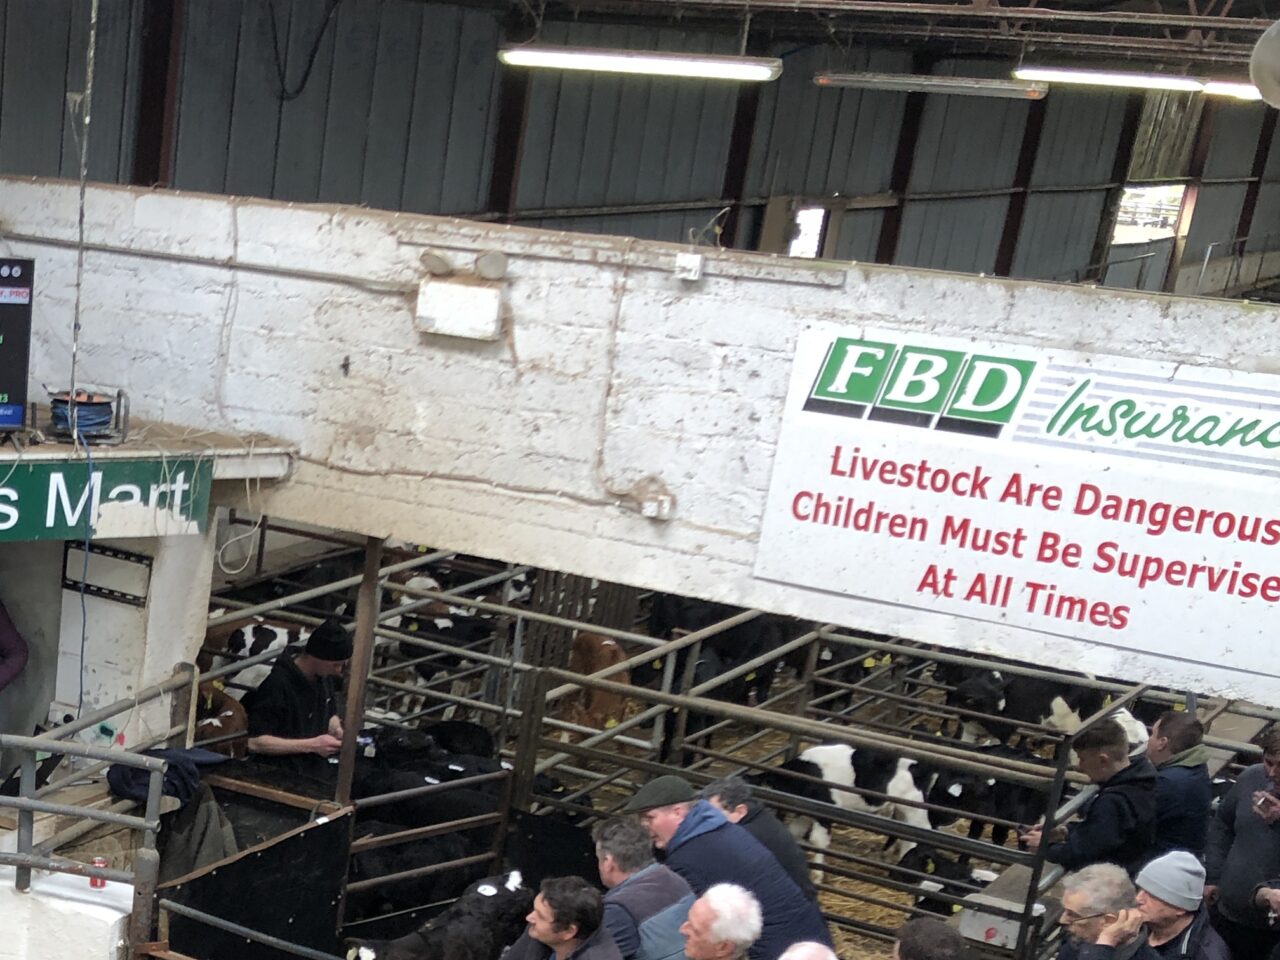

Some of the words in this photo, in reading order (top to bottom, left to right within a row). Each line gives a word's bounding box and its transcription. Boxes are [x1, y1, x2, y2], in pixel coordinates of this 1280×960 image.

[826, 344, 1022, 412] FBD
[1046, 379, 1280, 449] Insuranc
[790, 490, 928, 542] Children
[940, 515, 1027, 559] Must
[1036, 531, 1082, 568] Be
[1092, 541, 1280, 603] Supervise
[830, 445, 992, 500] Livestock
[1000, 473, 1063, 511] Are
[1074, 483, 1280, 546] Dangerous
[916, 565, 958, 598] At
[965, 573, 1014, 608] All
[1025, 581, 1130, 631] Times
